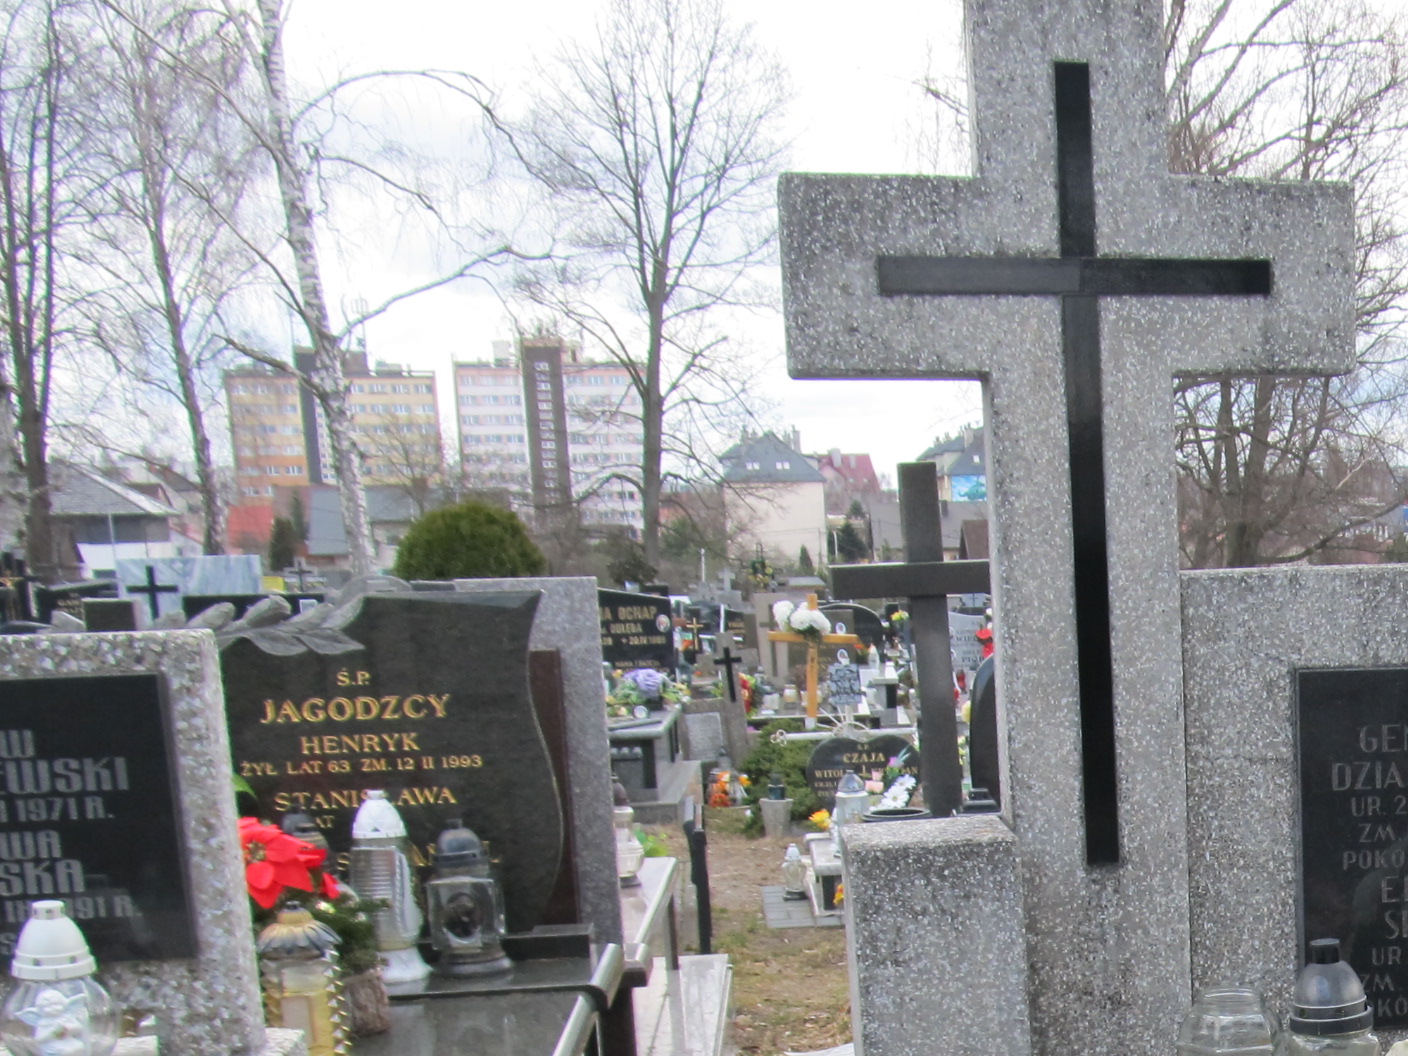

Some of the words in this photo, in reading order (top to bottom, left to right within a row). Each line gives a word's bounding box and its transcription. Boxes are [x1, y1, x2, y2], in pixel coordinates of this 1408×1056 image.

[336, 667, 371, 686] Ś.P.
[260, 693, 451, 724] JAGODZCY
[300, 732, 421, 755] HENRYK
[240, 760, 278, 777] ŻYŁ
[286, 760, 324, 775] LAT
[328, 759, 350, 773] 63
[361, 758, 392, 772] ZM.
[397, 757, 416, 770] 12
[422, 756, 435, 769] II
[441, 754, 483, 768] 1993
[843, 752, 885, 763] CZAJA
[0, 756, 130, 795] WSKI
[15, 797, 79, 822] 1971
[84, 796, 115, 820] R.
[274, 786, 458, 812] STANIAWA
[1351, 796, 1387, 818] UR.
